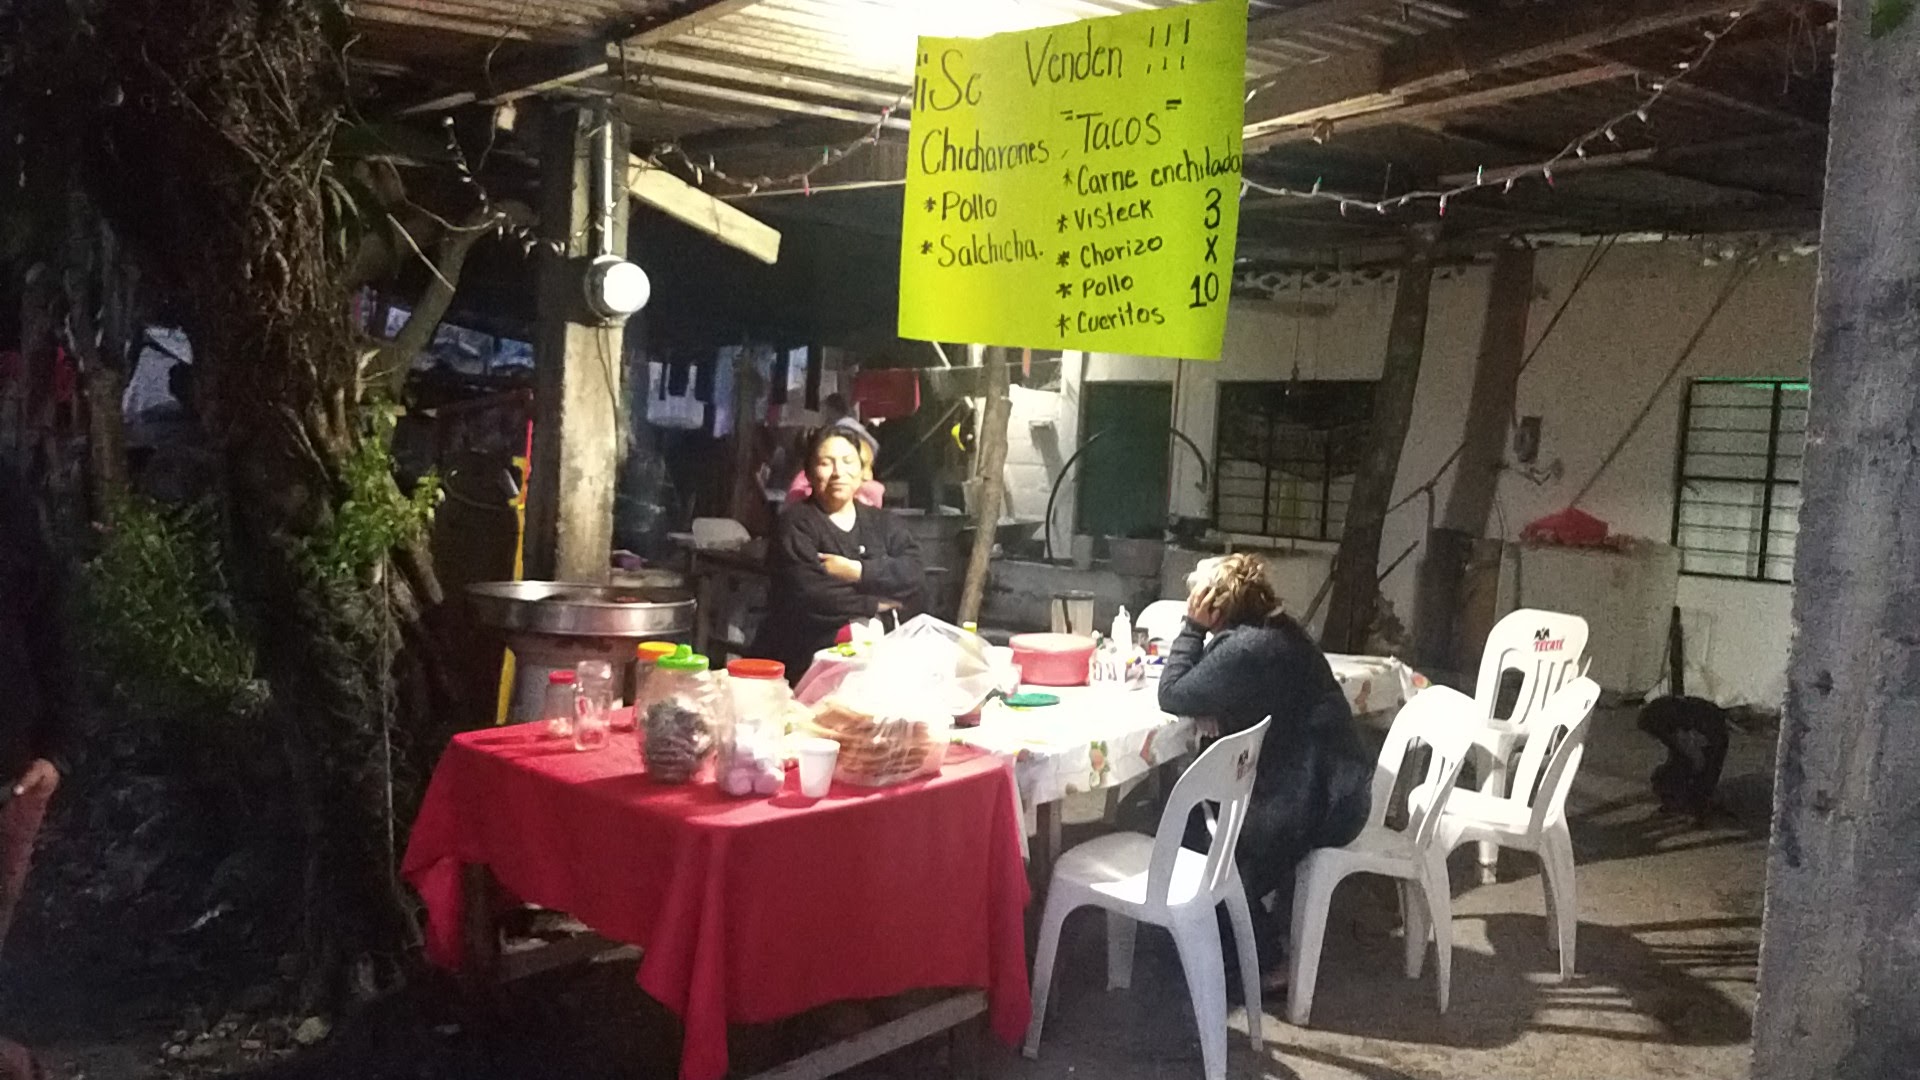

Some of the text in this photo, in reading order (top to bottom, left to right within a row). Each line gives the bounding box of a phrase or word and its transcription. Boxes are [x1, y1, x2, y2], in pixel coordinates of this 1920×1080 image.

[1026, 26, 1123, 86] Venden
[1077, 170, 1138, 197] Carne
[941, 191, 998, 222] Pollo
[1203, 187, 1222, 229] 3
[1079, 235, 1163, 269] Chorizo
[1082, 273, 1134, 299] Pollo
[1188, 272, 1220, 309] 10
[1076, 302, 1166, 333] Cueritos
